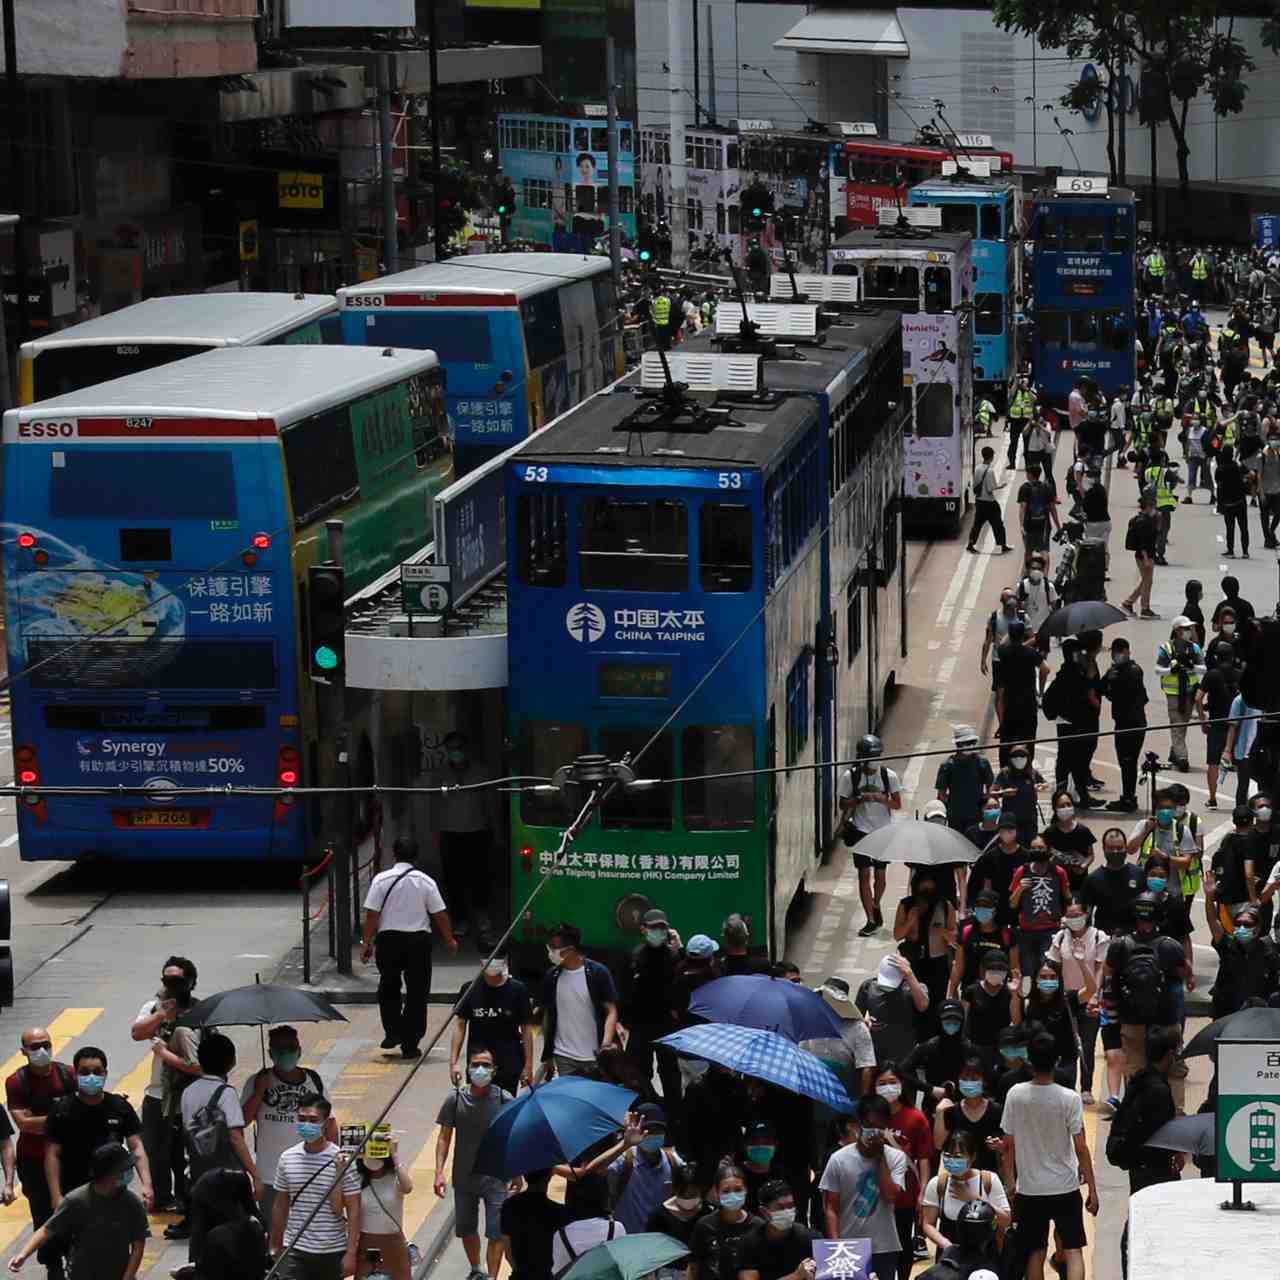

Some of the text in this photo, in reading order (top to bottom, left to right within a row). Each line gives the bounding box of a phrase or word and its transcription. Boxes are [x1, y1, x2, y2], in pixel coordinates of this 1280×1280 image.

[1071, 180, 1093, 192] 69
[346, 296, 384, 307] ESSO
[19, 422, 75, 438] ESSO
[524, 466, 549, 482] 53
[718, 472, 742, 488] 53
[188, 576, 272, 598] 保護引擎
[190, 602, 273, 624] 一路如新
[614, 609, 704, 629] 中国太平
[614, 630, 705, 641] CHINA TAIPING
[102, 739, 166, 757] Synergy
